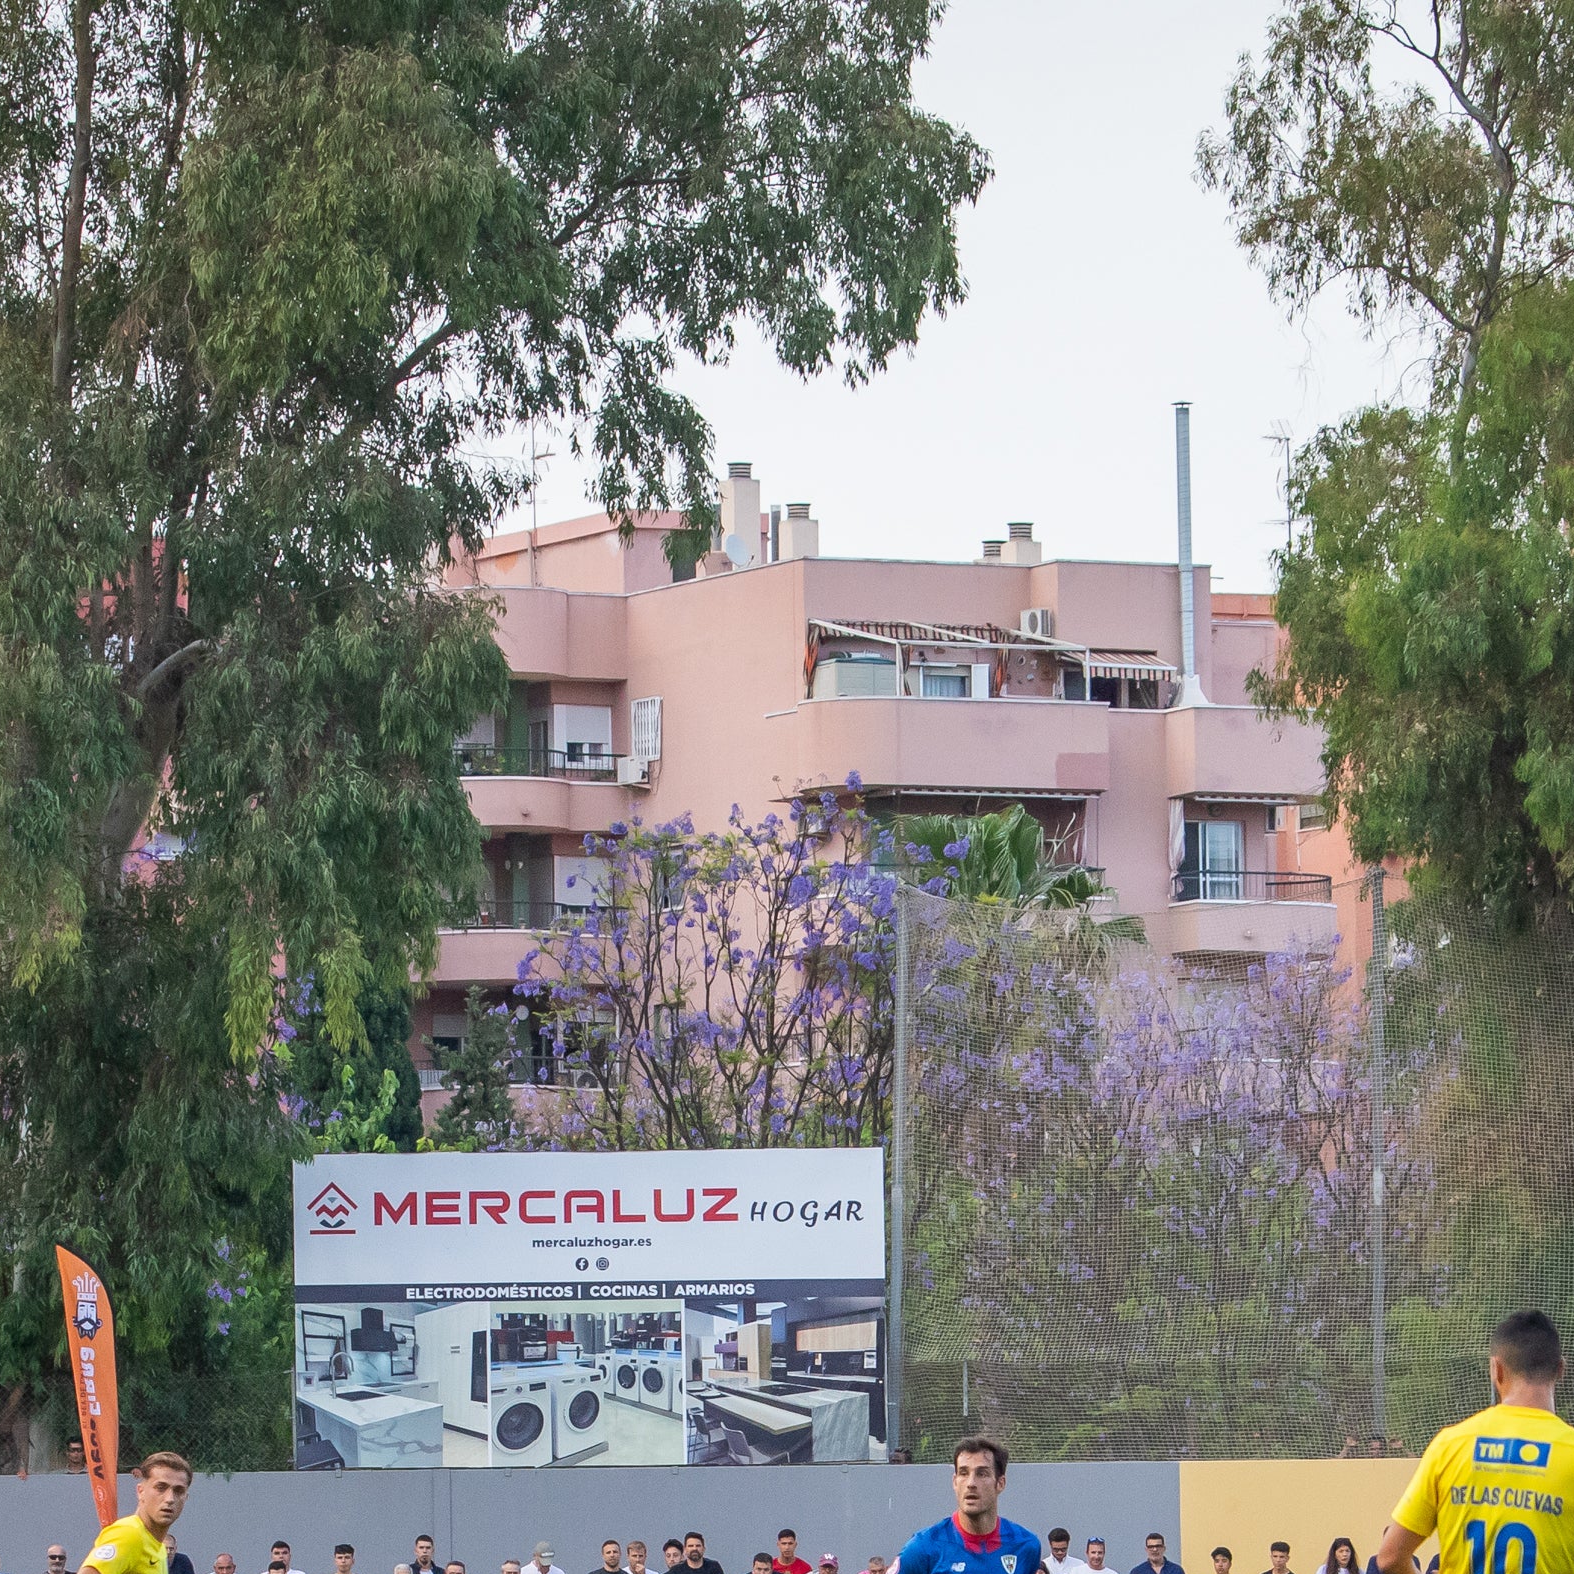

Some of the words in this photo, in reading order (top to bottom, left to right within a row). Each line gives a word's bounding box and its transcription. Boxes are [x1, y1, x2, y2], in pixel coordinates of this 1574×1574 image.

[374, 1188, 739, 1227] MERCALUZ
[750, 1199, 864, 1227] HOGAR
[531, 1236, 653, 1251] mercaluzhogar.es
[405, 1283, 574, 1300] ELECTRODOMÉSTICOS
[589, 1285, 658, 1298] COCINAS
[674, 1284, 756, 1297] ARMARIOS
[1478, 1442, 1506, 1459] TM
[1470, 1485, 1501, 1506] LAS
[1503, 1487, 1563, 1517] CUEVAS
